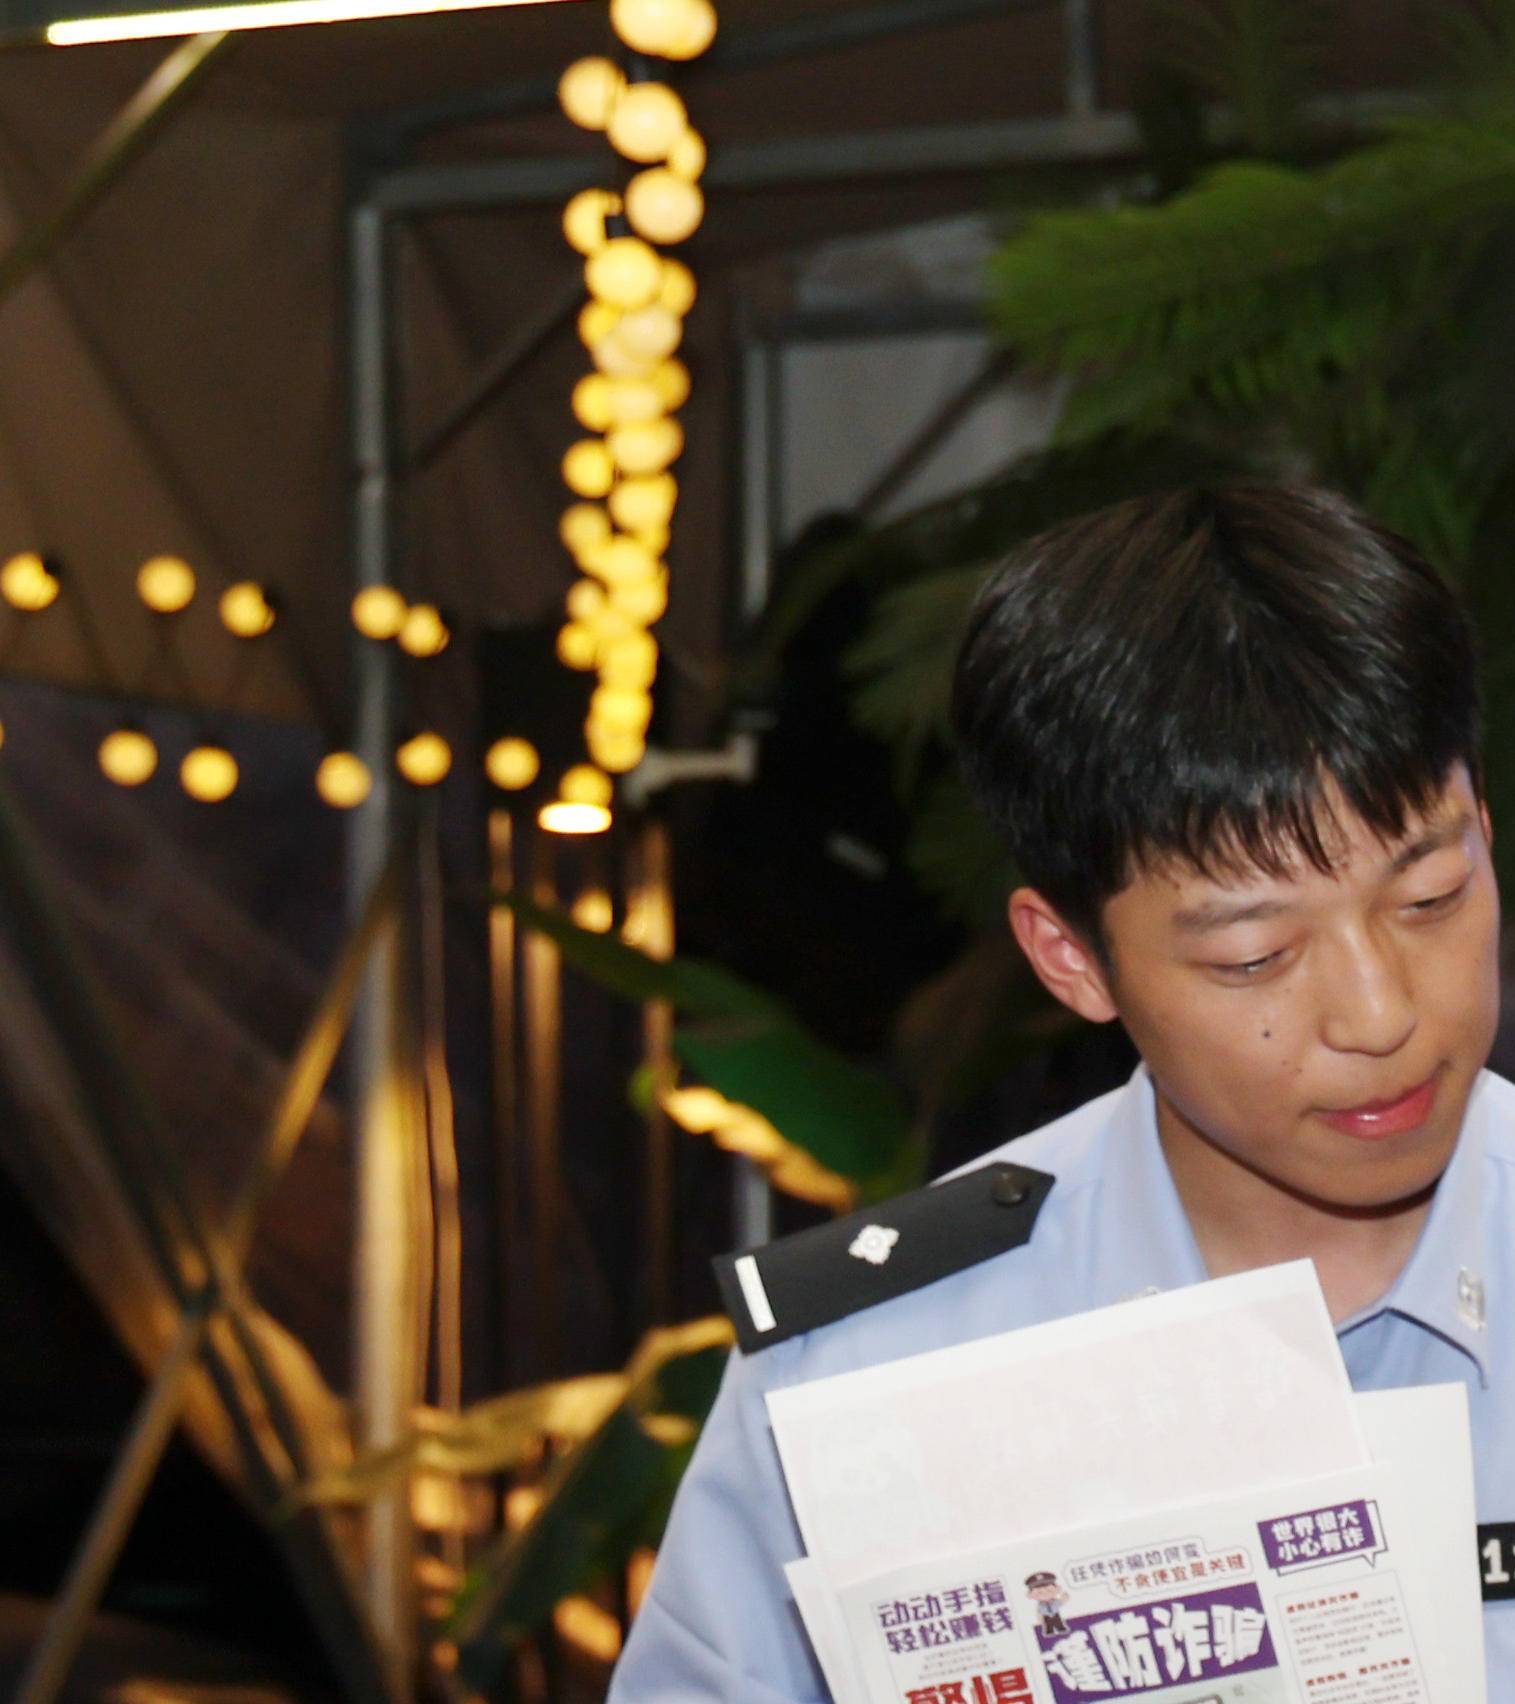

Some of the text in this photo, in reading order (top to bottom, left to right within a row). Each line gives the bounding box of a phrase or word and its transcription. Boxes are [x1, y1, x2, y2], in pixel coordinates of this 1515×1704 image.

[1272, 1506, 1360, 1542] 世界很大
[1278, 1526, 1365, 1562] 小心有诈
[878, 1580, 1006, 1629] 动动手指
[886, 1606, 1014, 1654] 轻松赚钱
[1044, 1602, 1266, 1693] 谨防诈骗
